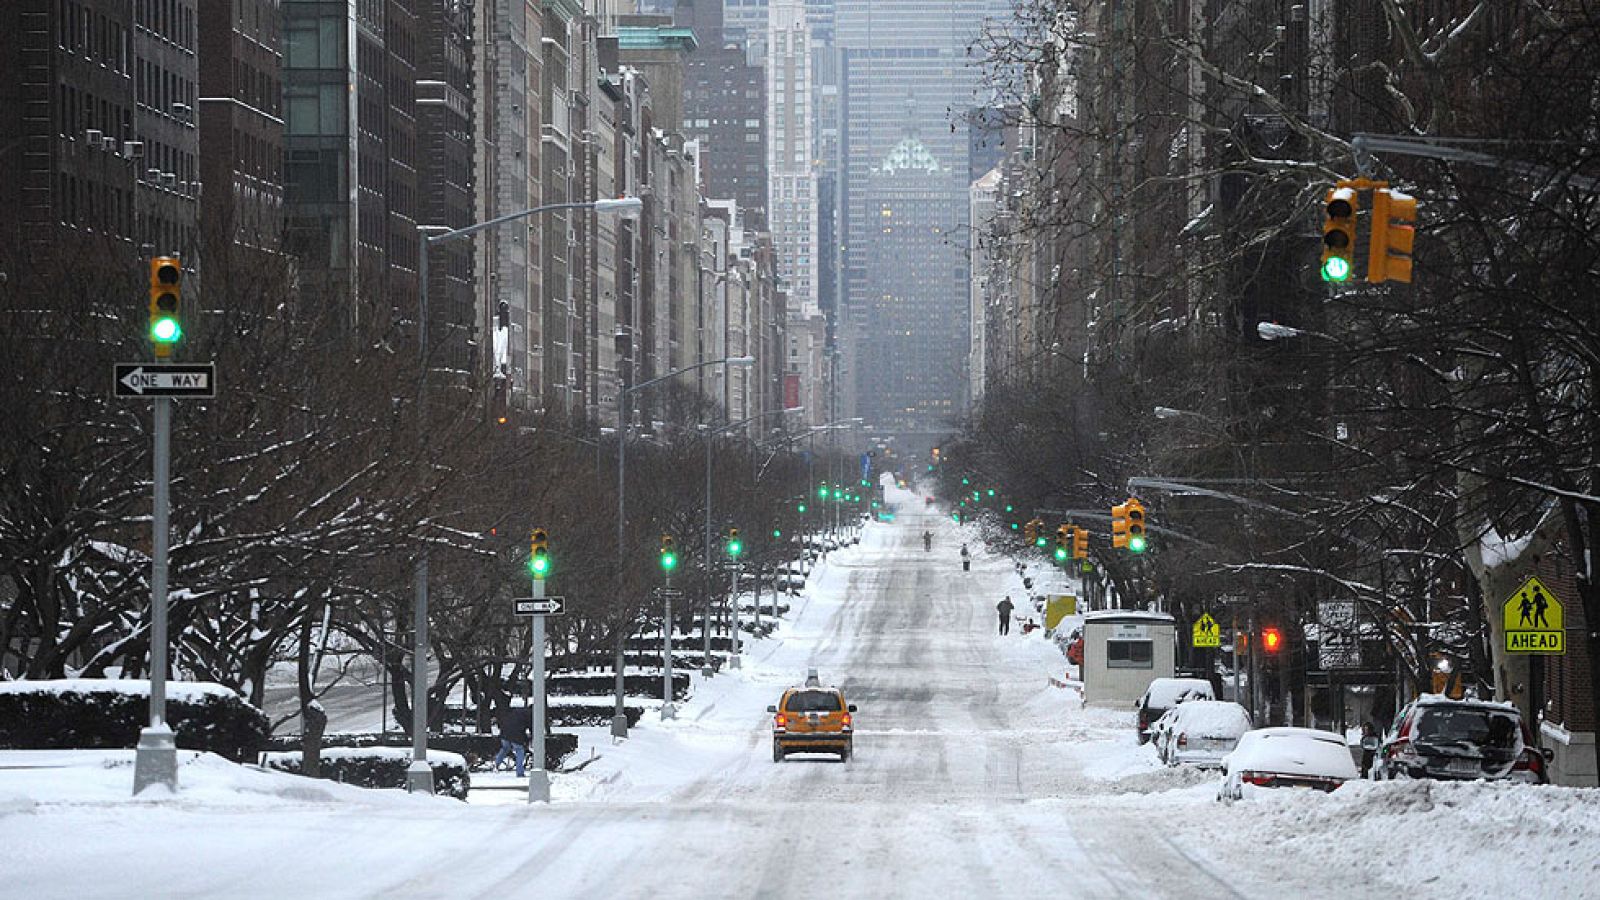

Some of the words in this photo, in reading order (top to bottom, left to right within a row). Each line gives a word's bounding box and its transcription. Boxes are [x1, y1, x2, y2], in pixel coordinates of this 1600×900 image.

[130, 374, 158, 387] ONE
[172, 374, 202, 387] WAY
[1511, 634, 1558, 648] AHEAD
